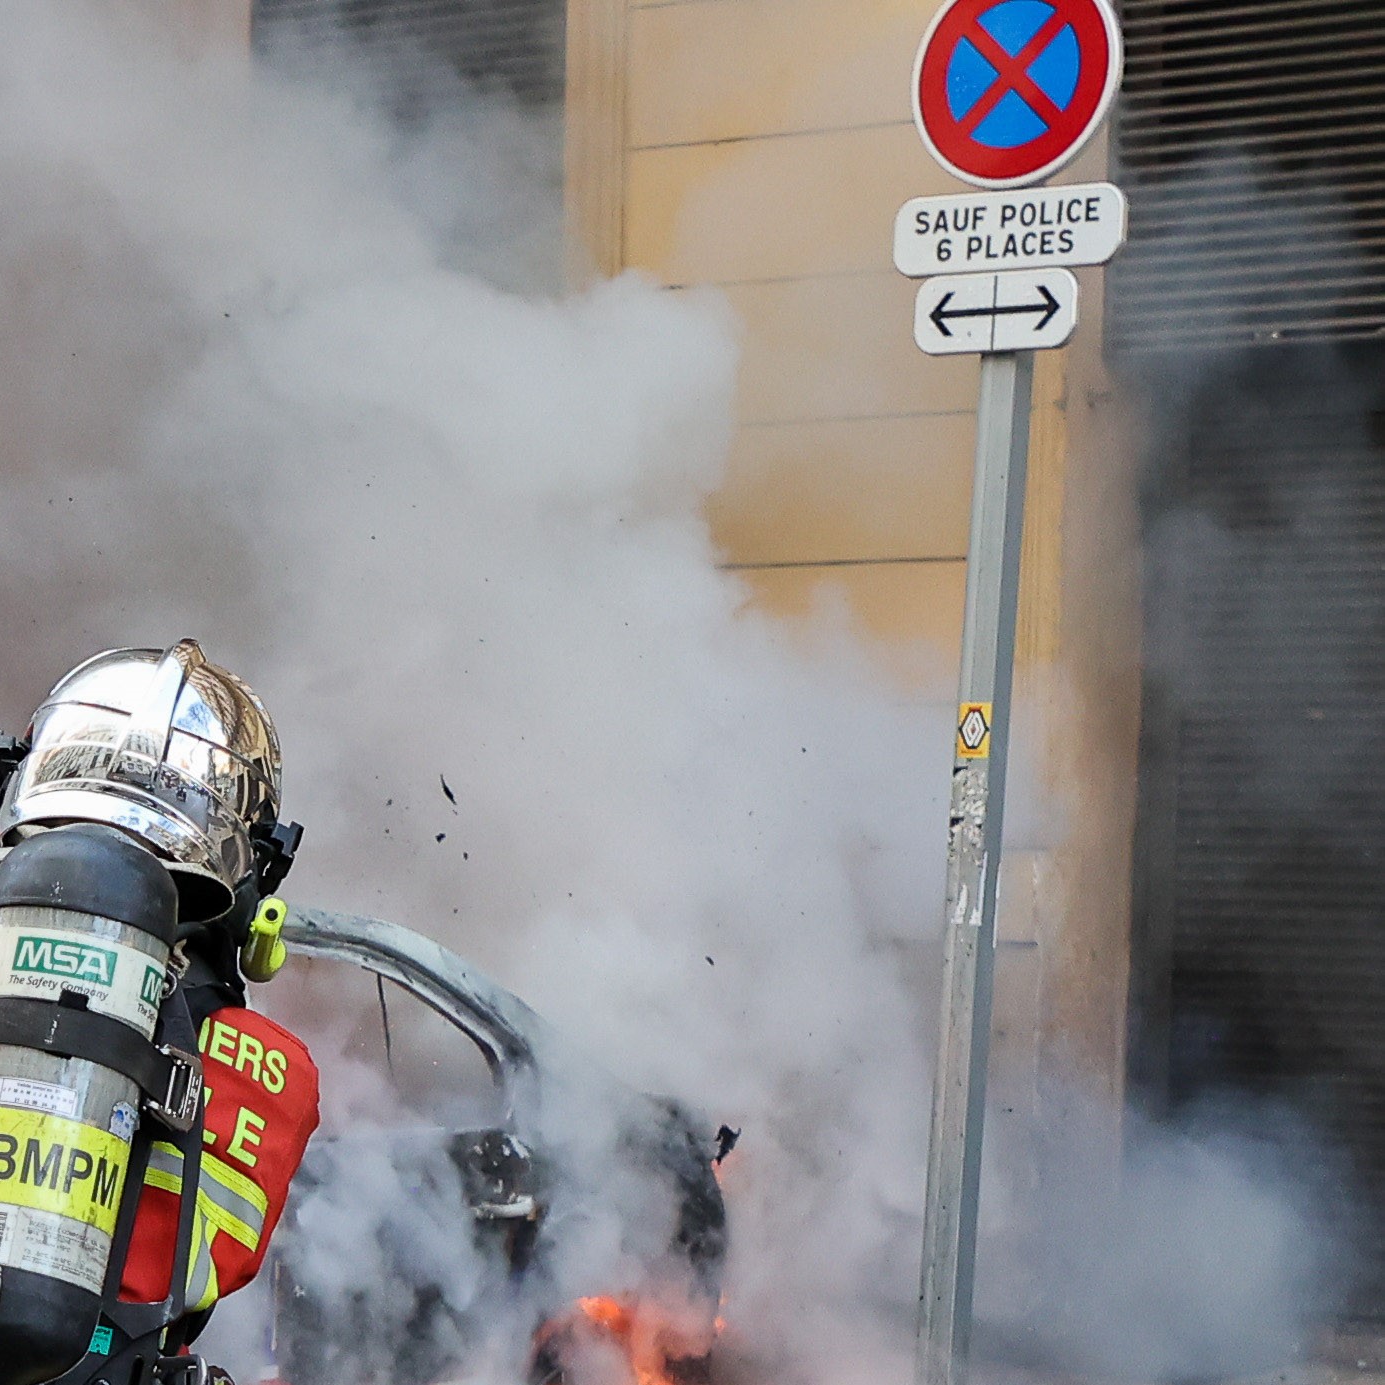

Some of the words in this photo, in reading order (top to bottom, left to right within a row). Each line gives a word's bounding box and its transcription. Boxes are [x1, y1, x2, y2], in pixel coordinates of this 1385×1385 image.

[915, 206, 987, 235] SAUF
[1000, 196, 1101, 229] POLICE
[936, 238, 952, 261] 6
[966, 230, 1074, 260] PLACES
[16, 940, 110, 983] MSA
[9, 974, 25, 985] The
[26, 975, 58, 990] Safety
[60, 980, 109, 1001] Company
[198, 1016, 288, 1094] IERS
